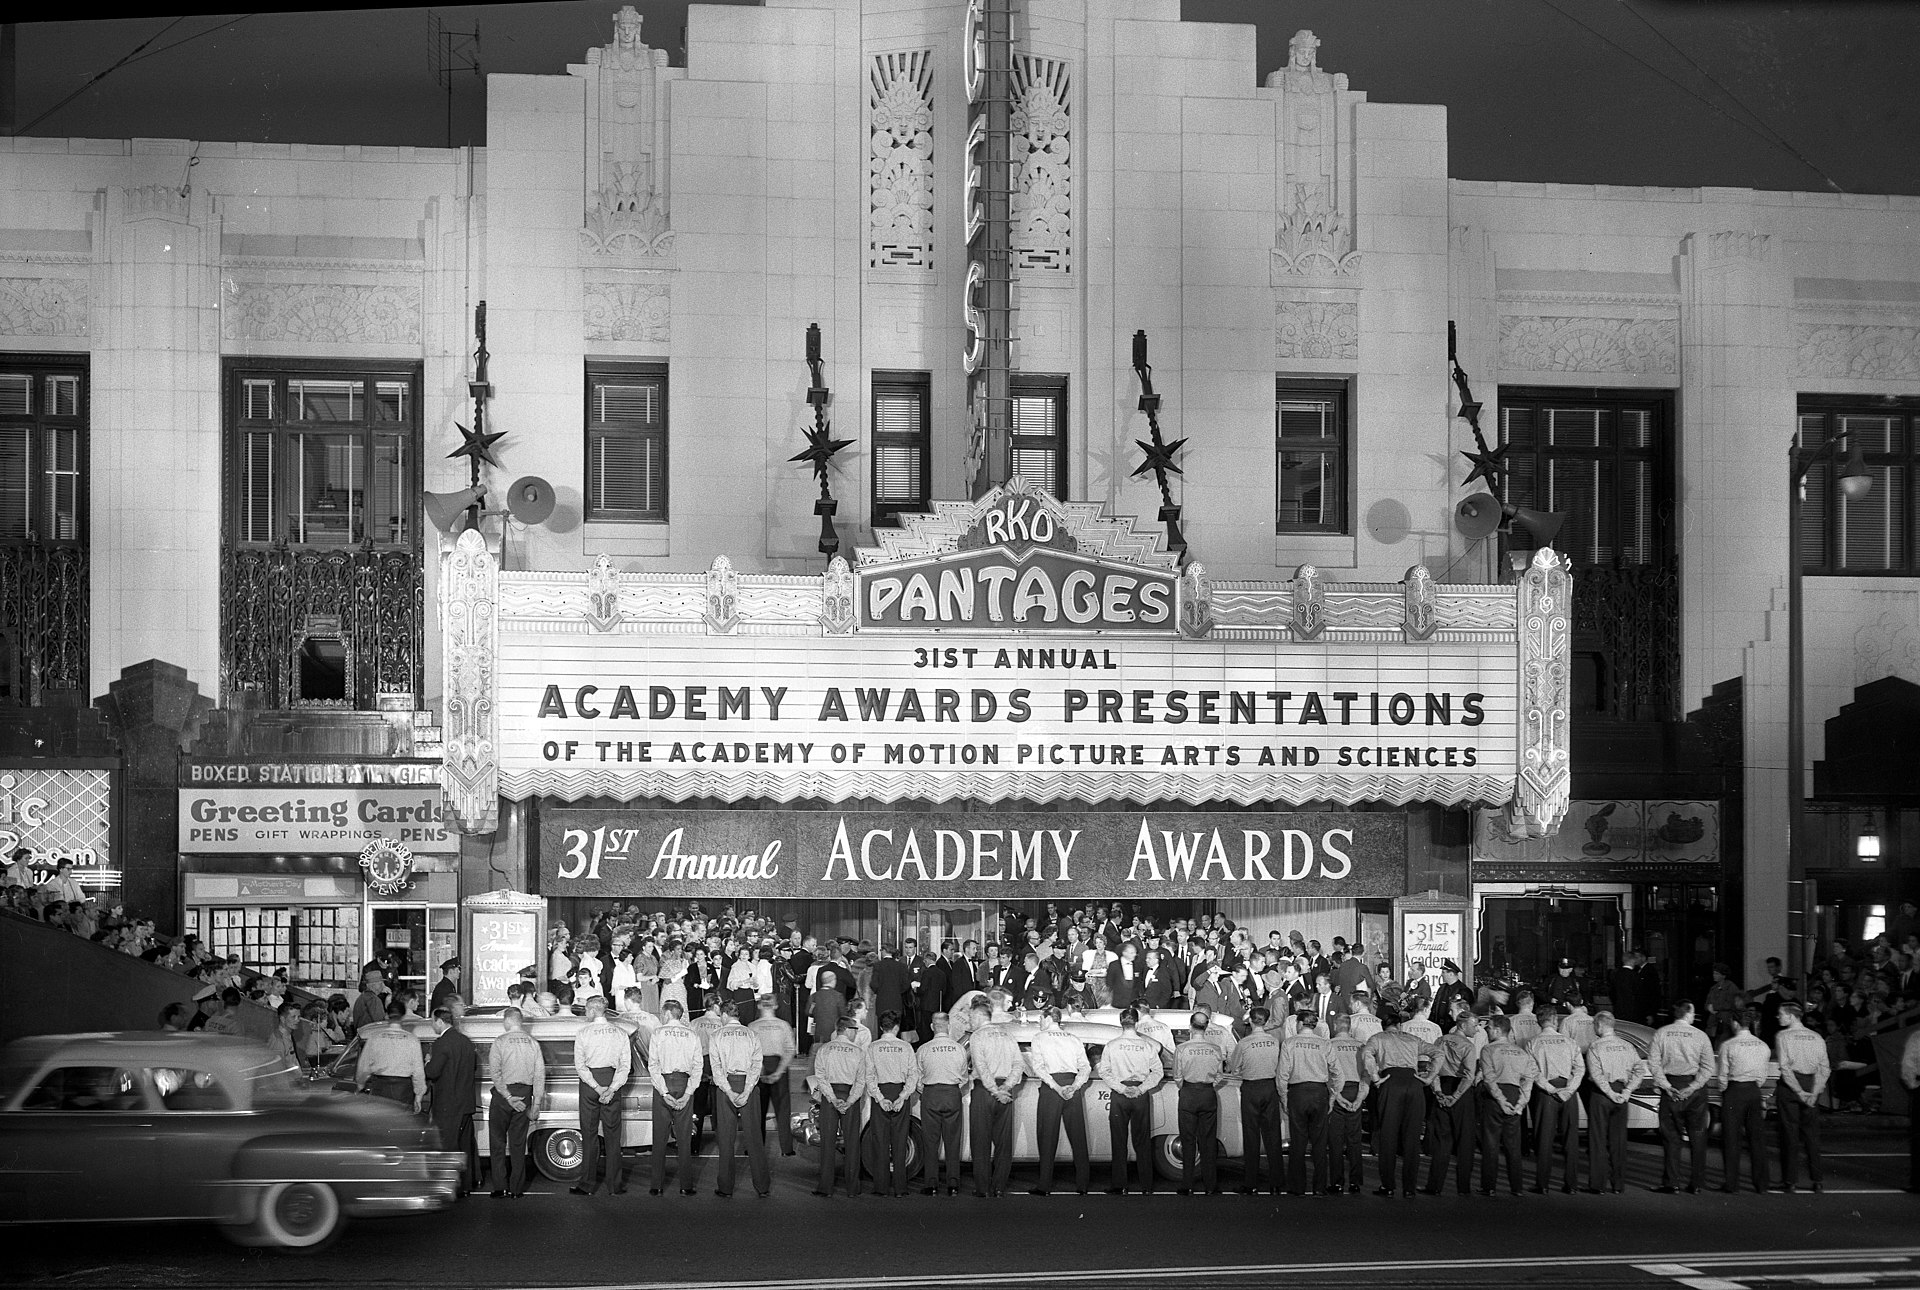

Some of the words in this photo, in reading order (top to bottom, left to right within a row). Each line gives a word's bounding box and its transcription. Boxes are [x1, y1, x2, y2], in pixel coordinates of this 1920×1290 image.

[986, 499, 1053, 544] RKO
[869, 565, 1170, 623] PANTAGES
[914, 648, 978, 668] 31ST
[995, 648, 1117, 670] ANNUAL
[538, 684, 788, 721] ACADEMY
[818, 688, 1031, 723] AWARDS
[1064, 689, 1486, 726] PRESENTATIONS
[543, 741, 578, 761] OF
[595, 742, 652, 762] THE
[668, 743, 814, 763] ACADEMY
[830, 743, 866, 763] OF
[884, 743, 1001, 764] MOTION
[1017, 745, 1144, 765] PICTURE
[1160, 746, 1241, 766] ARTS
[1257, 746, 1320, 766] AND
[1337, 747, 1477, 767] SCIENCES
[191, 765, 249, 782] BOXED
[400, 766, 442, 783] GIFT
[190, 799, 349, 827] Greeting
[357, 799, 444, 823] Cards
[190, 829, 239, 841] PENS
[255, 830, 288, 839] GIFT
[299, 830, 382, 839] WRAPPINGS
[400, 829, 448, 841] PENS
[646, 827, 782, 880] Annual
[820, 816, 1082, 881] ACADEMY
[1124, 816, 1353, 882] AWARDS
[367, 878, 407, 896] PENS
[592, 1027, 617, 1036] SYSTEM
[664, 1030, 690, 1038] SYSTEM
[722, 1030, 748, 1038] SYSTEM
[1666, 1030, 1693, 1038] SYSTEM
[828, 1045, 854, 1053] SYSTEM
[878, 1045, 903, 1053] SYSTEM
[931, 1045, 957, 1053] SYSTEM
[1119, 1043, 1145, 1053] SYSTEM
[1251, 1040, 1275, 1049] SYSTEM
[1295, 1041, 1320, 1051] SYSTEM
[1189, 1048, 1214, 1056] SYSTEM
